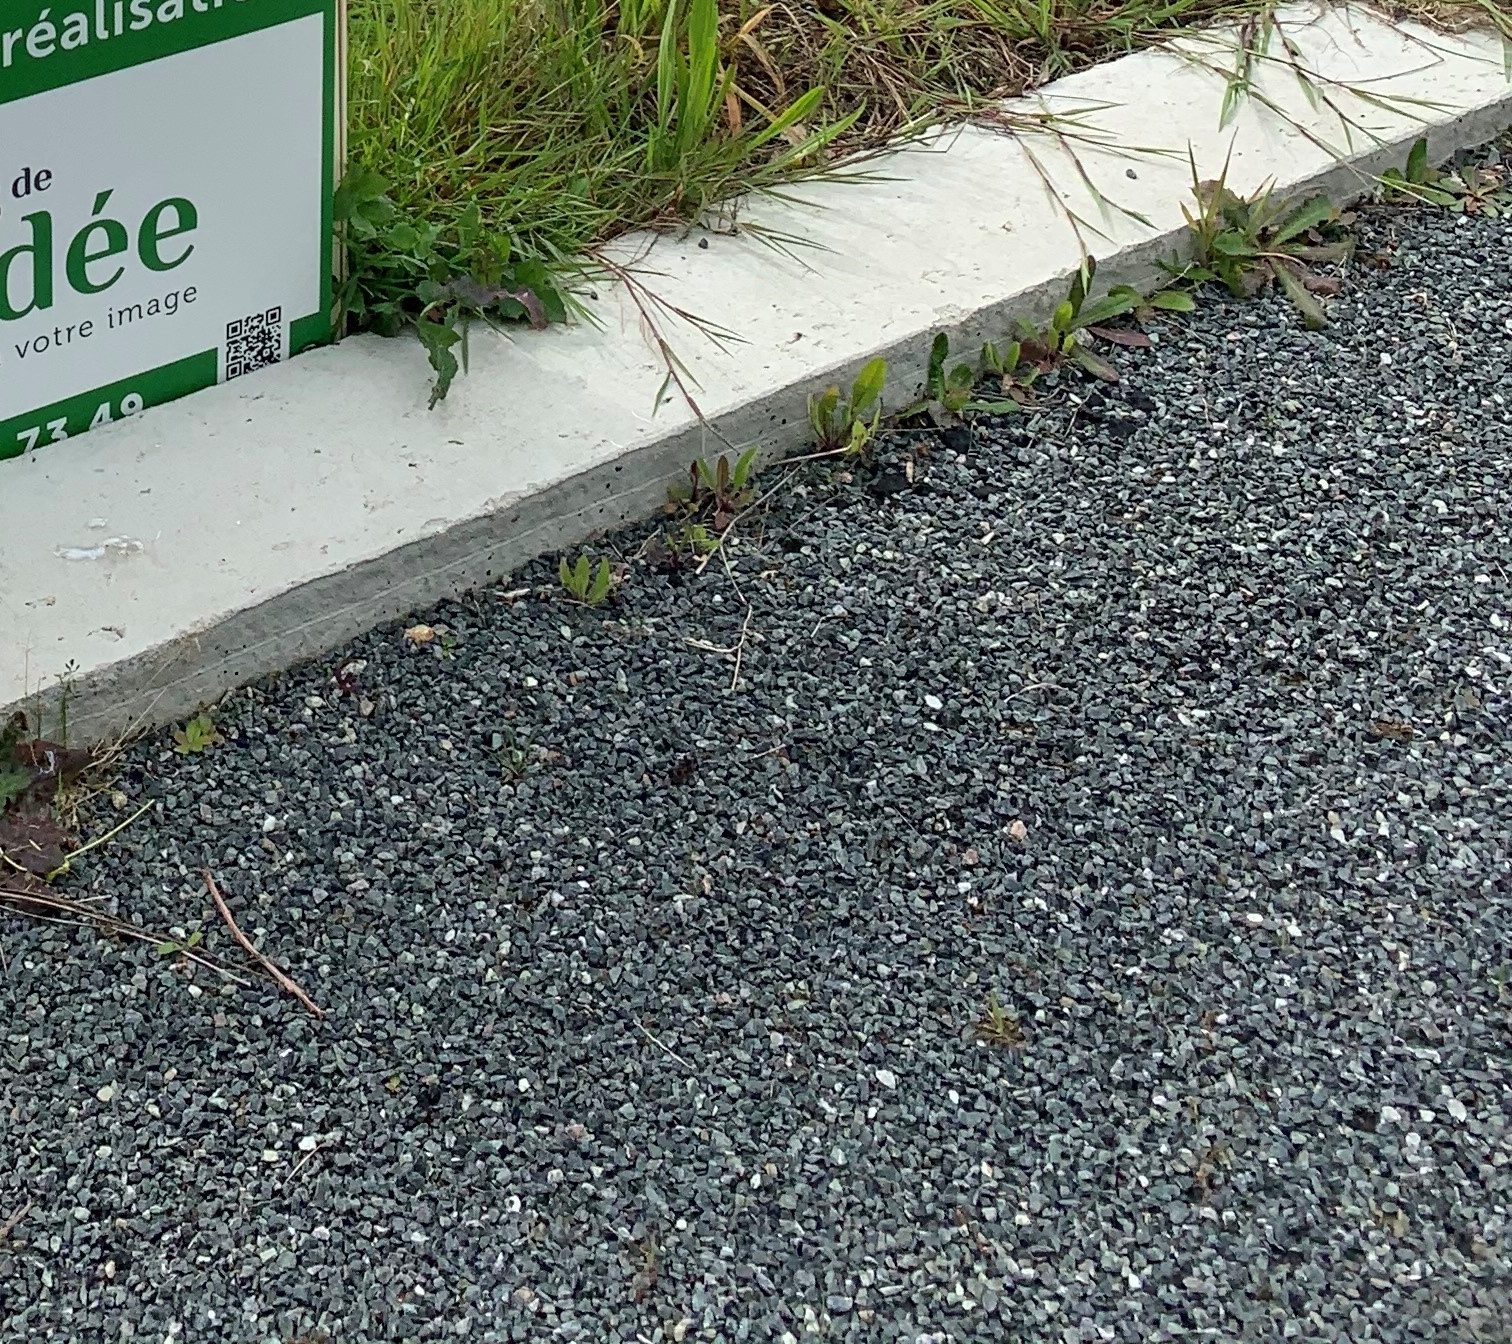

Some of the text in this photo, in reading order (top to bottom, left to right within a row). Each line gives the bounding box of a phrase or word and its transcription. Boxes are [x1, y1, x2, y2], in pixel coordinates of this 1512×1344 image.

[11, 167, 53, 199] de
[14, 317, 94, 360] votre
[107, 285, 199, 330] image
[16, 417, 69, 455] 73
